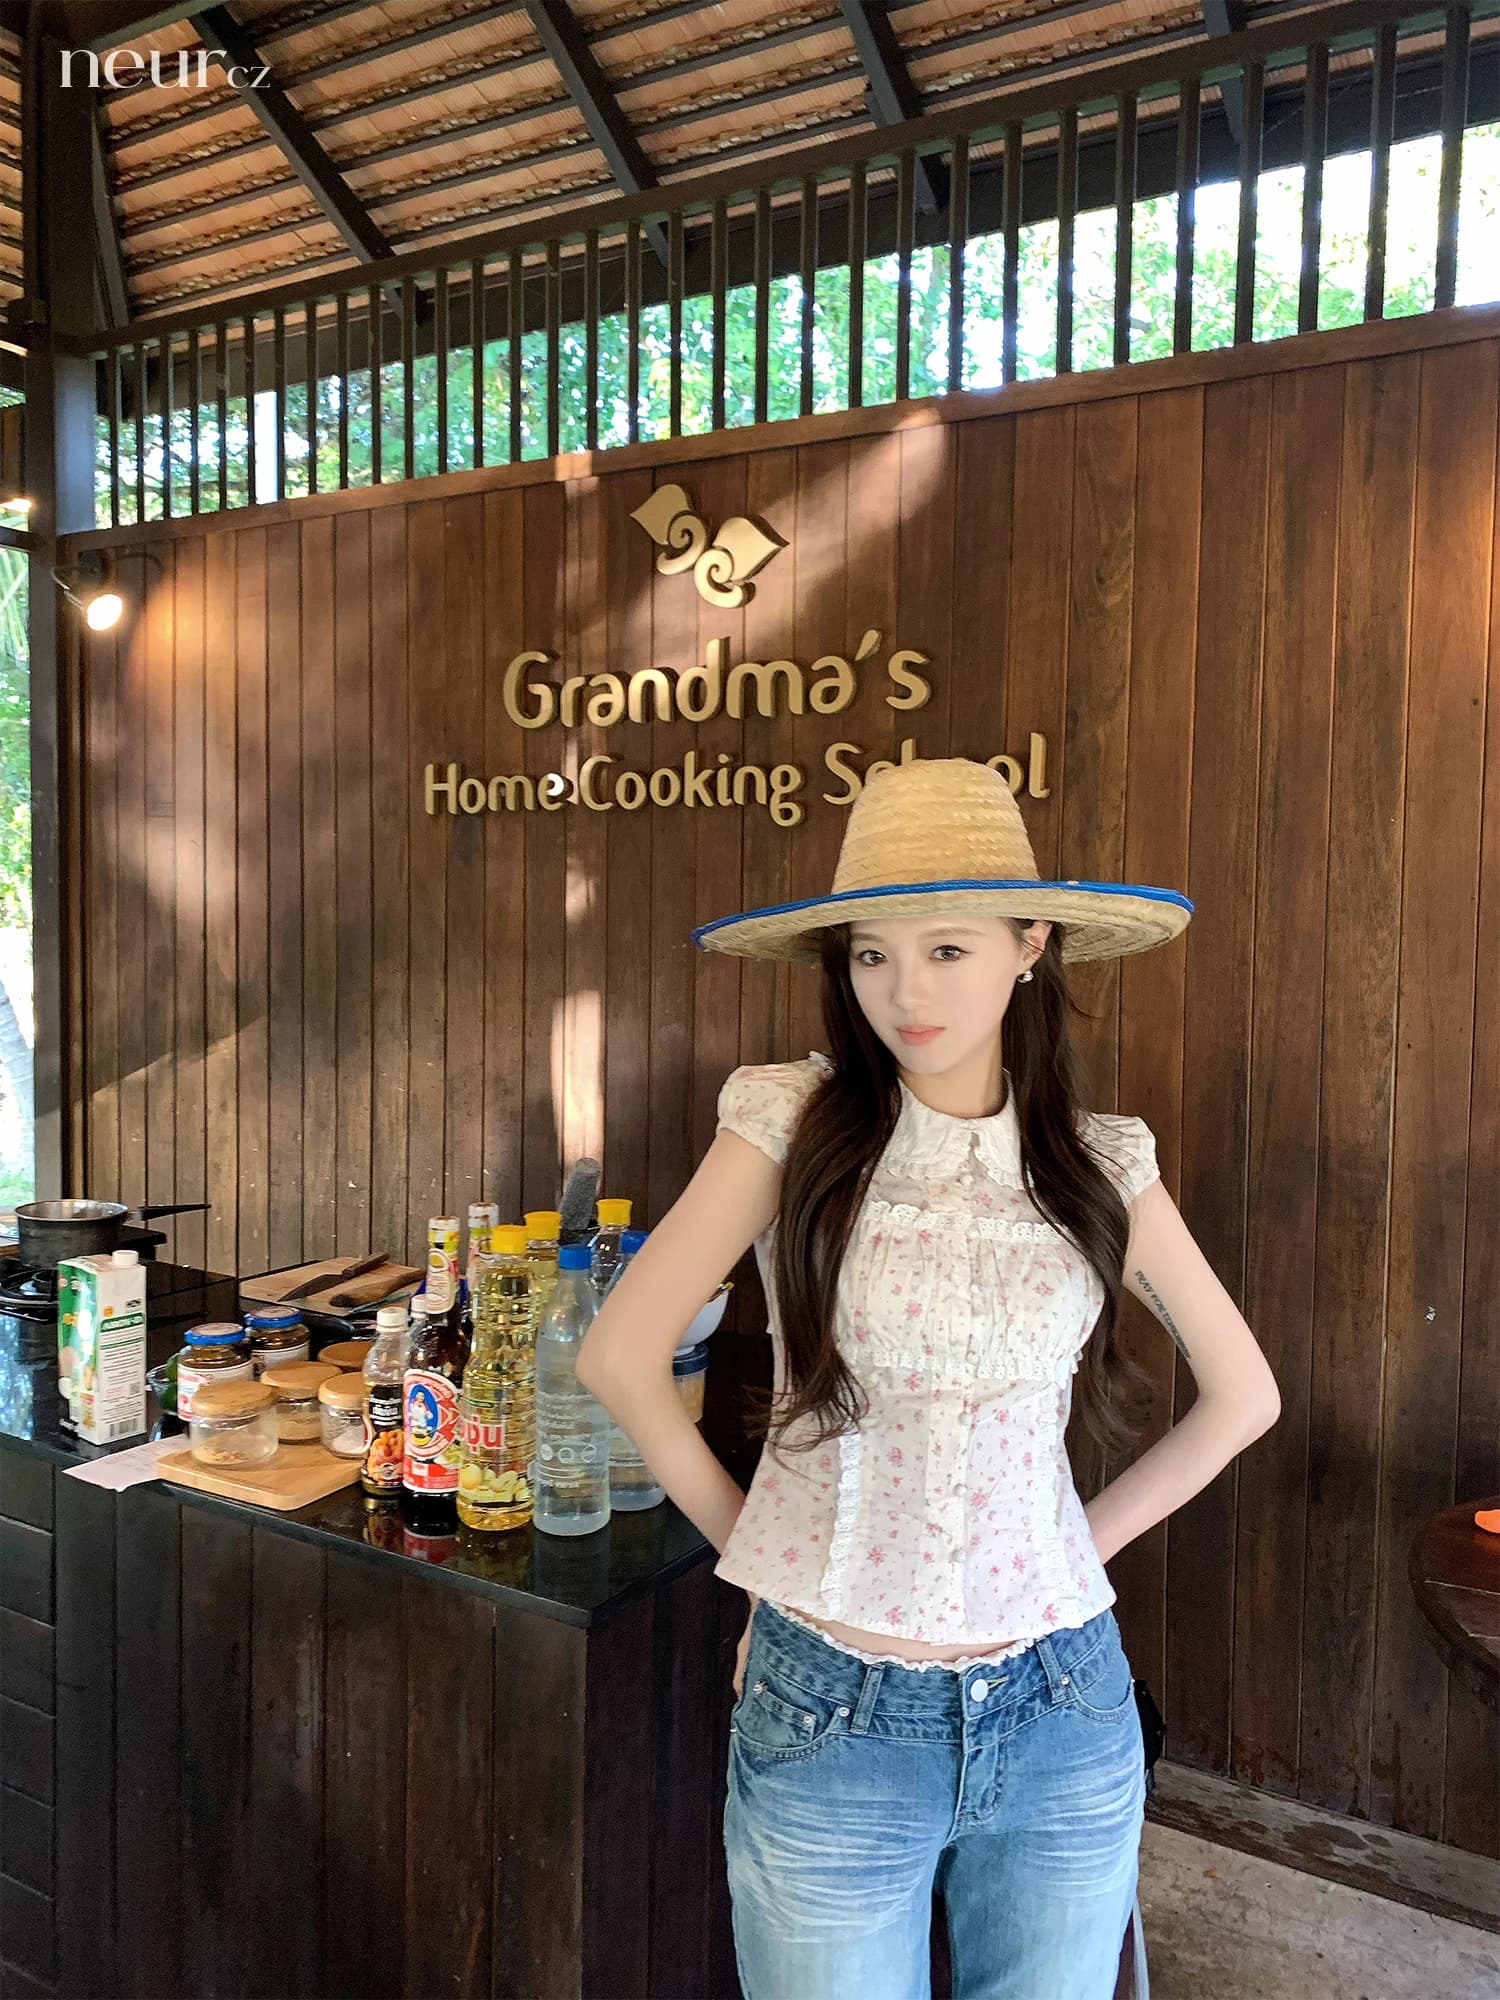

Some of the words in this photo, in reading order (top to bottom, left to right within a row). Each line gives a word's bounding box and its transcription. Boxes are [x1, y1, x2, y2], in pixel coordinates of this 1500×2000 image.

[503, 630, 931, 730] Grandma's
[424, 762, 565, 816] Home
[579, 749, 803, 829] Cooking
[822, 731, 1051, 806] Sol
